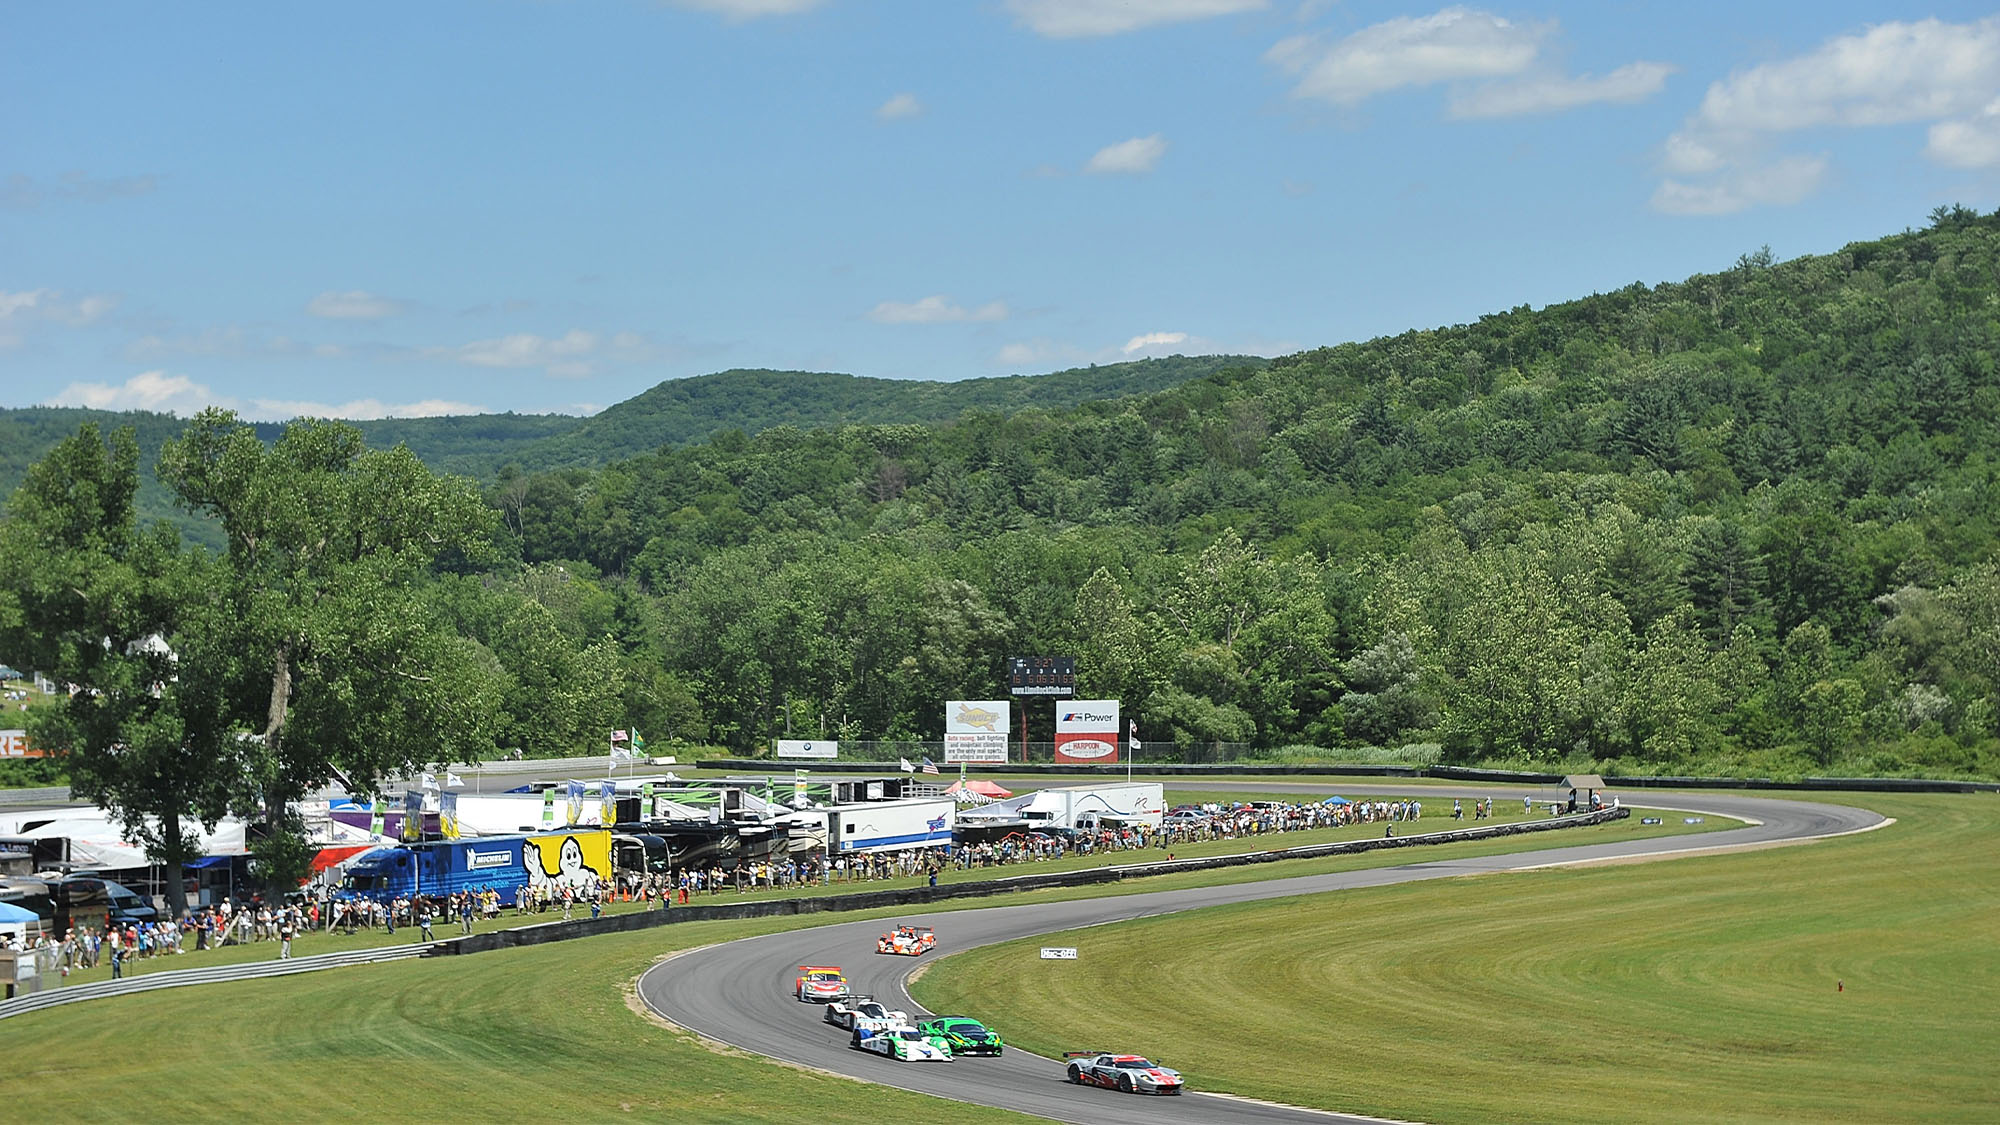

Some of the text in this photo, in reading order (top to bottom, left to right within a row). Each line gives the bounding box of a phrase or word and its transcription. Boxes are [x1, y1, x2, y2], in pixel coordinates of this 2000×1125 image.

[1084, 712, 1113, 722] Power
[1072, 742, 1100, 750] HARPOON
[476, 854, 510, 863] MICHELIN
